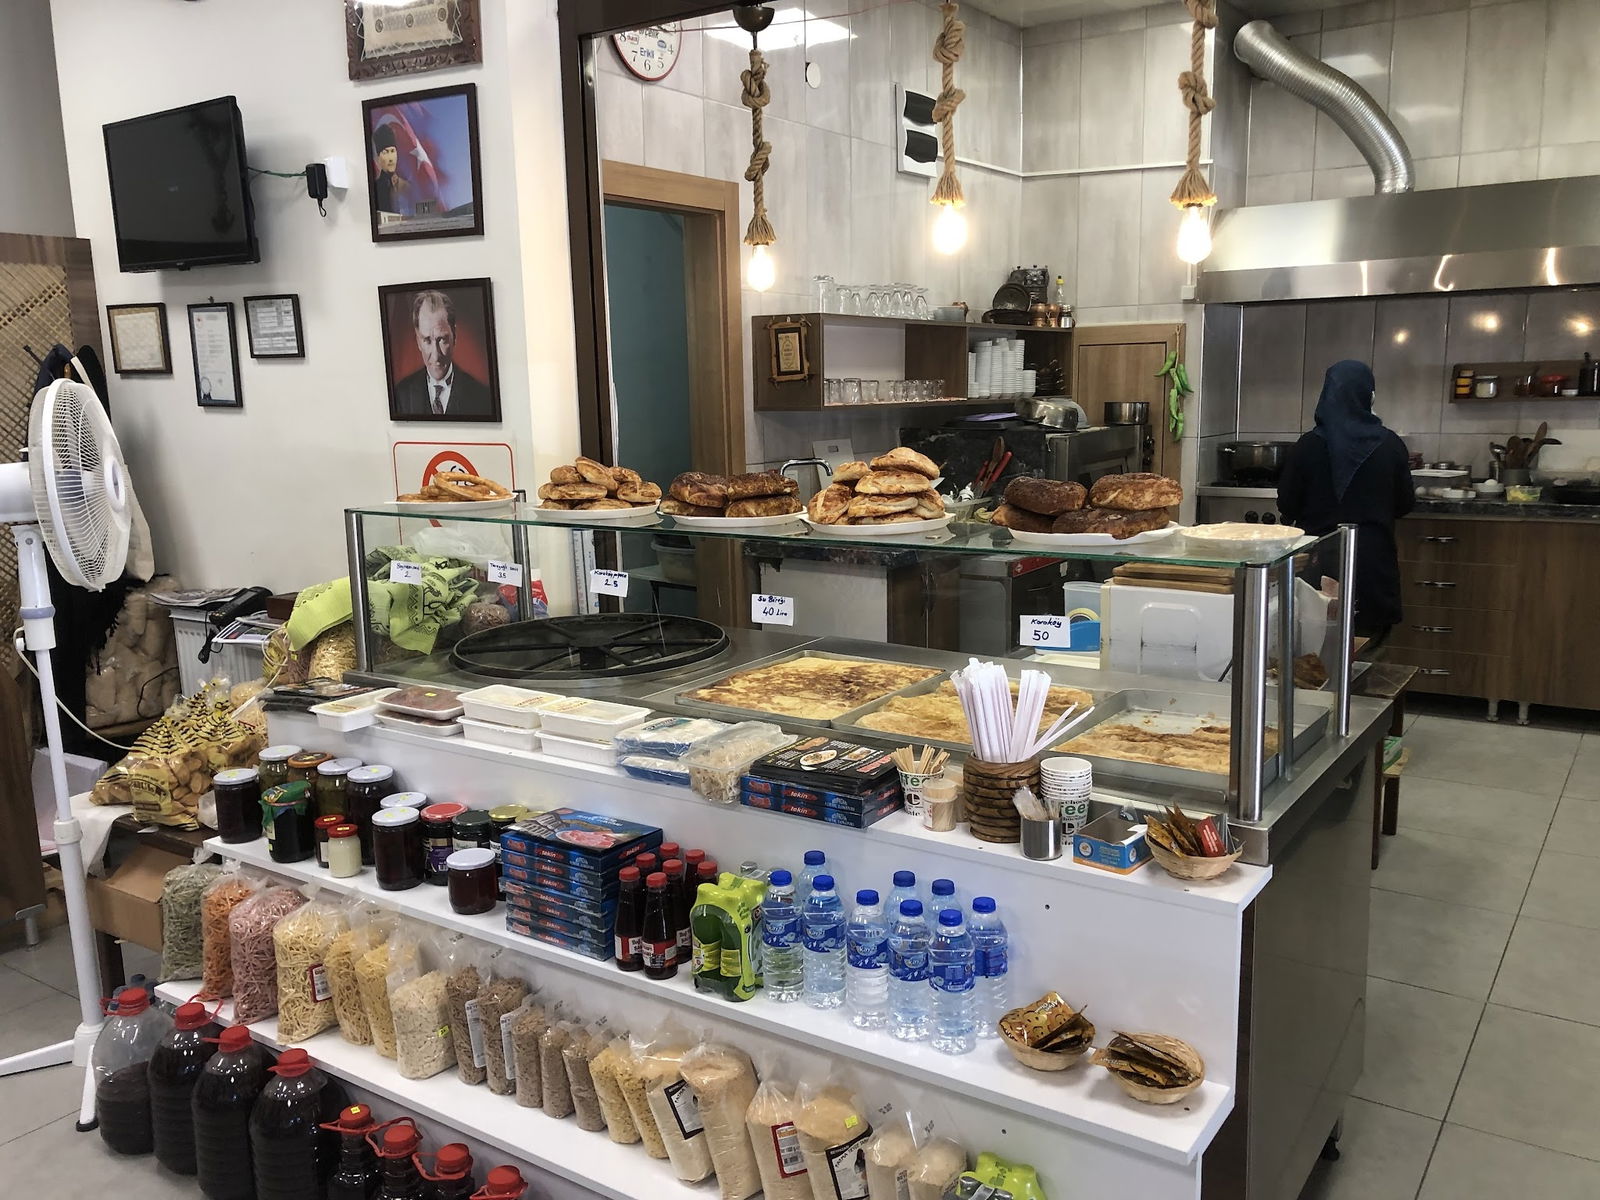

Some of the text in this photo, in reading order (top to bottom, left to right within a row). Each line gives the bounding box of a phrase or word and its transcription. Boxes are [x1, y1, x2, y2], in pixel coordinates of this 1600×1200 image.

[667, 44, 675, 55] 4
[631, 50, 638, 62] 7
[643, 60, 651, 71] 6
[657, 56, 665, 69] 5
[762, 606, 775, 617] 40
[1032, 629, 1050, 641] 50
[790, 790, 809, 799] tekin
[790, 805, 809, 815] tekin
